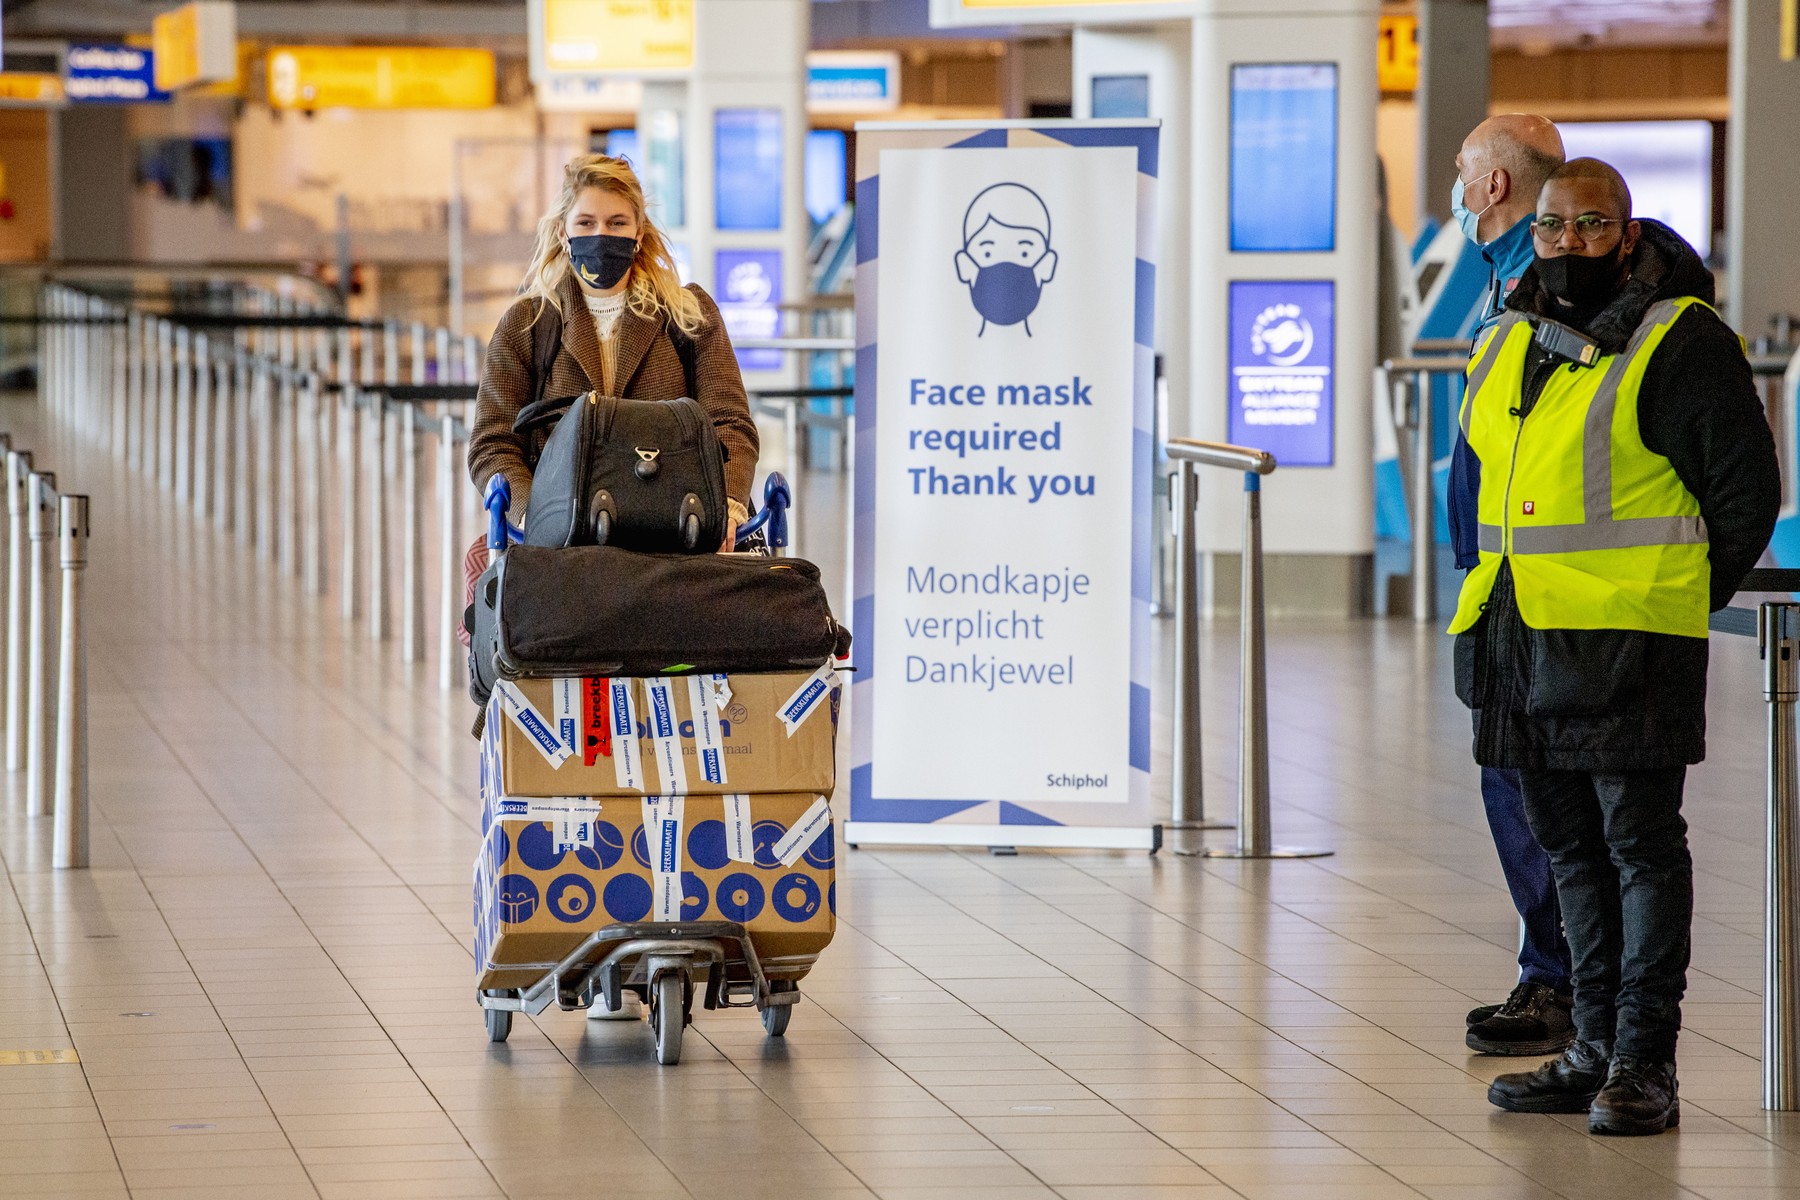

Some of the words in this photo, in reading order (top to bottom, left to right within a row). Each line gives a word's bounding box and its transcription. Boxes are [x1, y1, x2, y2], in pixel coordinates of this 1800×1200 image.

[909, 378, 986, 406] Face
[997, 376, 1093, 406] mask
[909, 421, 1061, 458] required
[908, 466, 1017, 495] Thank
[1028, 475, 1096, 504] you
[907, 564, 1090, 603] Mondkapje
[905, 609, 1044, 646] verplicht
[906, 653, 1073, 692] Dankjewel
[1046, 773, 1108, 790] Schiphol
